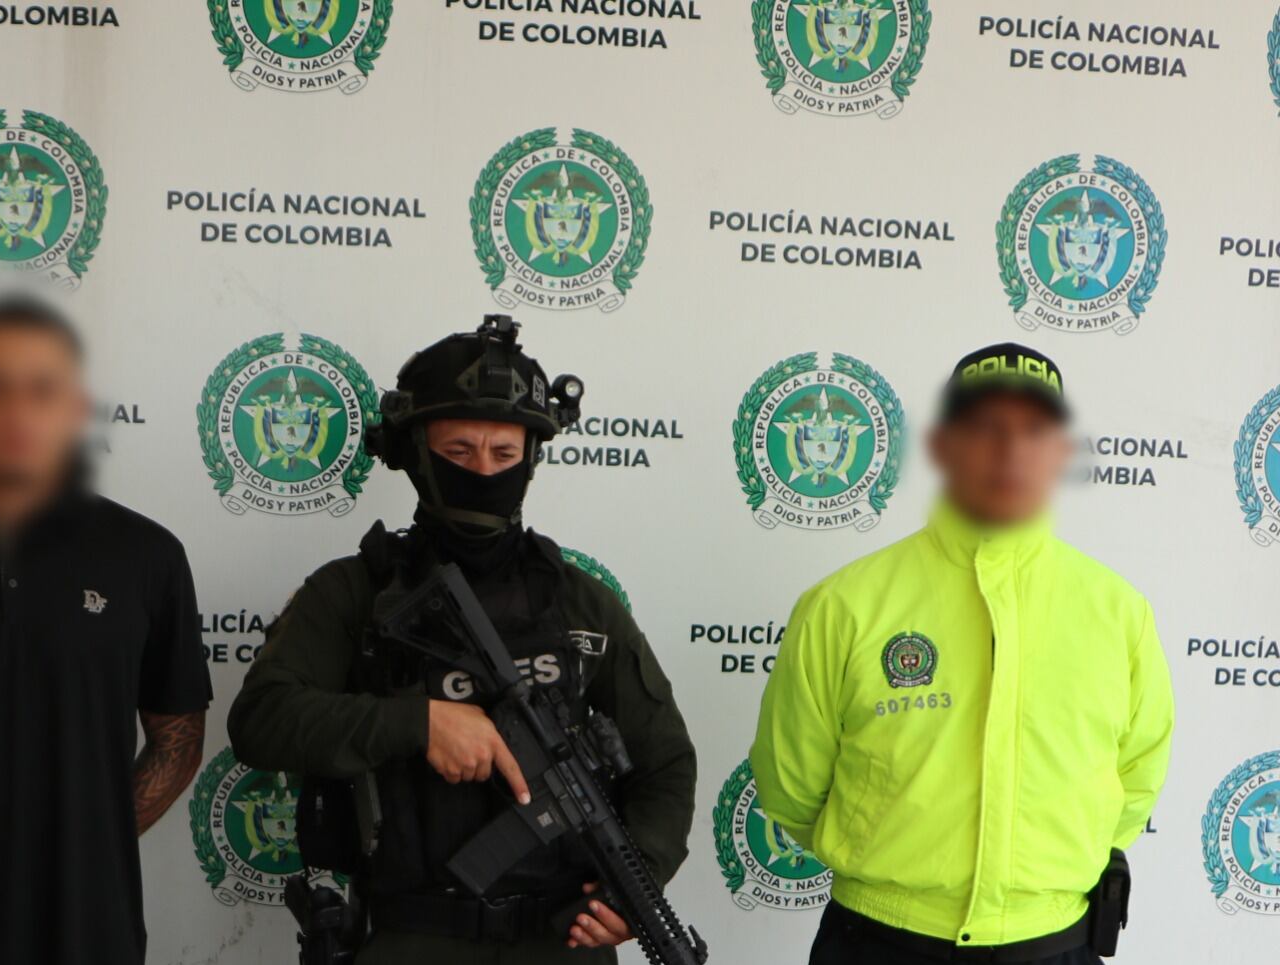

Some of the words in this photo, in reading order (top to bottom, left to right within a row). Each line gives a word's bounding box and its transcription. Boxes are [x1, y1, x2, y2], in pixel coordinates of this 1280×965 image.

[561, 0, 701, 19] NACIONAL
[479, 21, 514, 41] DE
[523, 23, 667, 48] COLOMBIA
[978, 14, 1080, 41] POLICÍA
[1088, 23, 1220, 49] NACIONAL
[840, 55, 901, 95] NACIONAL
[1009, 49, 1044, 69] DE
[1051, 52, 1187, 77] COLOMBIA
[793, 89, 824, 109] DIOS
[839, 94, 883, 112] PATRIA
[556, 149, 575, 159] DE
[590, 159, 629, 232] COLOMBIA
[166, 188, 275, 213] POLICÍA
[283, 194, 425, 219] NACIONAL
[709, 209, 812, 234] POLICÍA
[821, 216, 955, 241] NACIONAL
[1079, 175, 1097, 185] DE
[1110, 185, 1144, 257] COLOMBIA
[200, 223, 237, 243] DE
[244, 224, 392, 248] COLOMBIA
[1220, 237, 1280, 258] POLI
[740, 242, 775, 262] DE
[783, 245, 922, 269] COLOMBIA
[561, 250, 622, 289] NACIONAL
[1248, 268, 1280, 287] DE
[514, 284, 544, 304] DIOS
[560, 288, 606, 306] PATRIA
[1079, 273, 1138, 312] NACIONAL
[1035, 307, 1062, 326] DIOS
[1066, 319, 1073, 328] Y
[1077, 311, 1120, 328] PATRIA
[284, 354, 303, 364] DE
[319, 364, 359, 436] COLOMBIA
[817, 373, 835, 382] DE
[849, 382, 887, 453] COLOMBIA
[561, 417, 683, 438] ACIONAL
[540, 446, 650, 467] LOMBIA
[1088, 437, 1188, 458] CIONAL
[290, 453, 354, 494] NACIONAL
[1092, 466, 1156, 486] MBIA
[243, 490, 273, 510] DIOS
[289, 492, 336, 511] PATRIA
[819, 470, 879, 509] NACIONAL
[774, 505, 803, 524] DIOS
[806, 516, 813, 525] Y
[818, 508, 861, 526] PATRIA
[199, 609, 264, 633] LICÍA
[1188, 636, 1280, 658] POLICÍA
[722, 654, 755, 673] DE
[443, 654, 561, 700] GES
[1215, 668, 1246, 685] DE
[875, 693, 951, 716] 607463
